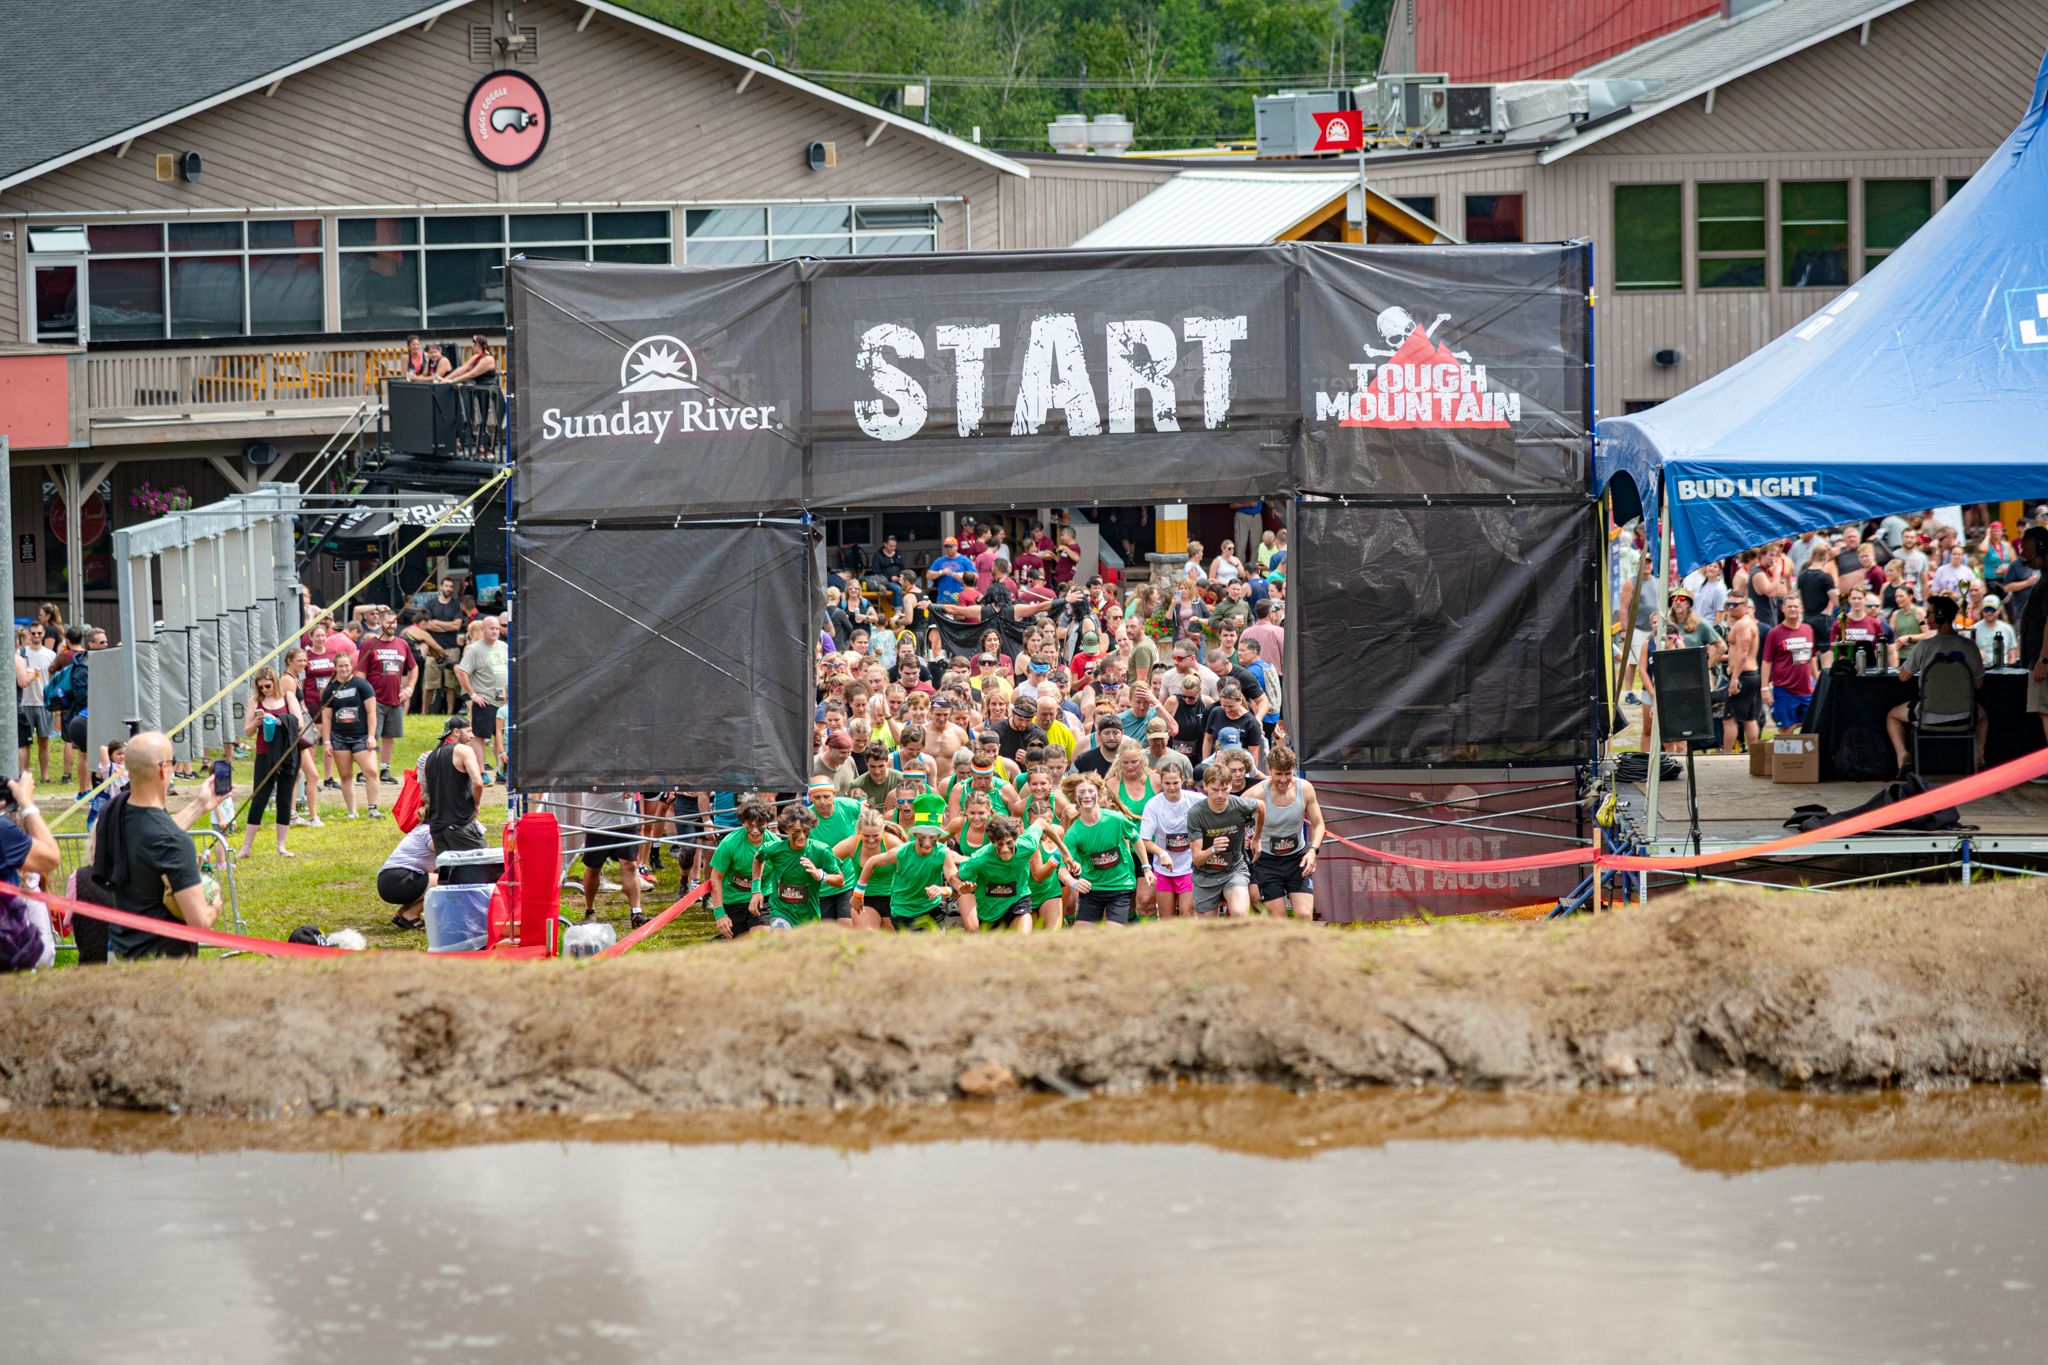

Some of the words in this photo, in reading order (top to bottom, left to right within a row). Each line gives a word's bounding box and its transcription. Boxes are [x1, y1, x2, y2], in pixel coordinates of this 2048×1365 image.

[482, 87, 508, 110] GOGGLE
[854, 312, 1248, 441] START
[1349, 363, 1488, 393] TOUGH
[542, 401, 673, 444] Sunday
[680, 397, 776, 433] River
[1315, 391, 1521, 422] MOUNTAIN
[1678, 478, 1735, 500] BUD
[1738, 476, 1818, 497] LIGHT
